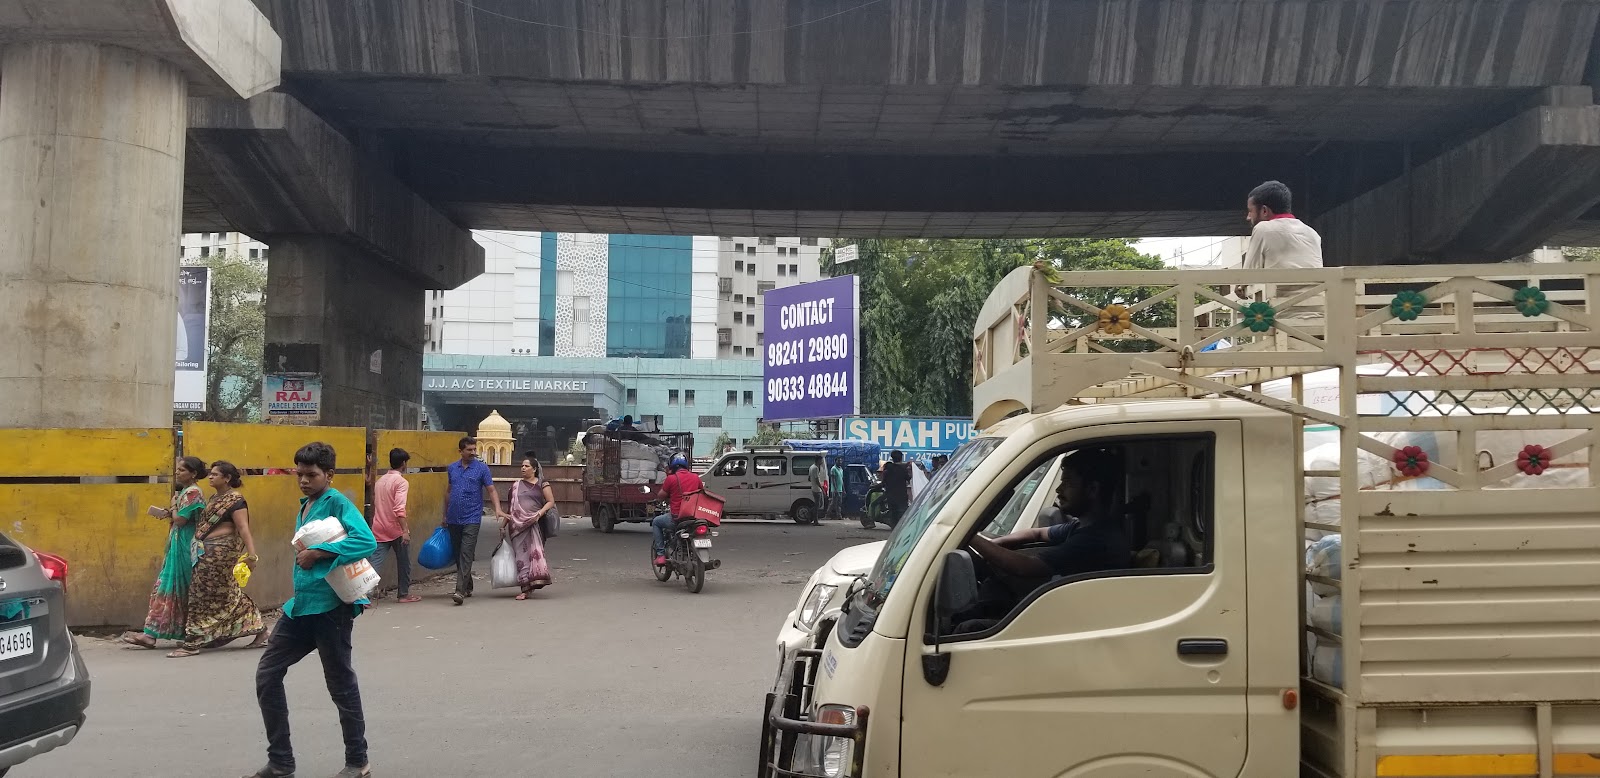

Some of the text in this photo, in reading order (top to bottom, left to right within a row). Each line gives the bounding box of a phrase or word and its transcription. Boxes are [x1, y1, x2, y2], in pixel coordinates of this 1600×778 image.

[780, 297, 835, 330] CONTACT
[768, 333, 848, 367] 98241 29890
[276, 391, 312, 402] RAJ
[428, 378, 588, 391] J.J. A/C TEXTILE MARKET
[767, 371, 848, 403] 90333 48844
[268, 402, 318, 410] PARCEL SERVICE
[849, 420, 940, 448] SHAH
[0, 631, 32, 655] G4696
